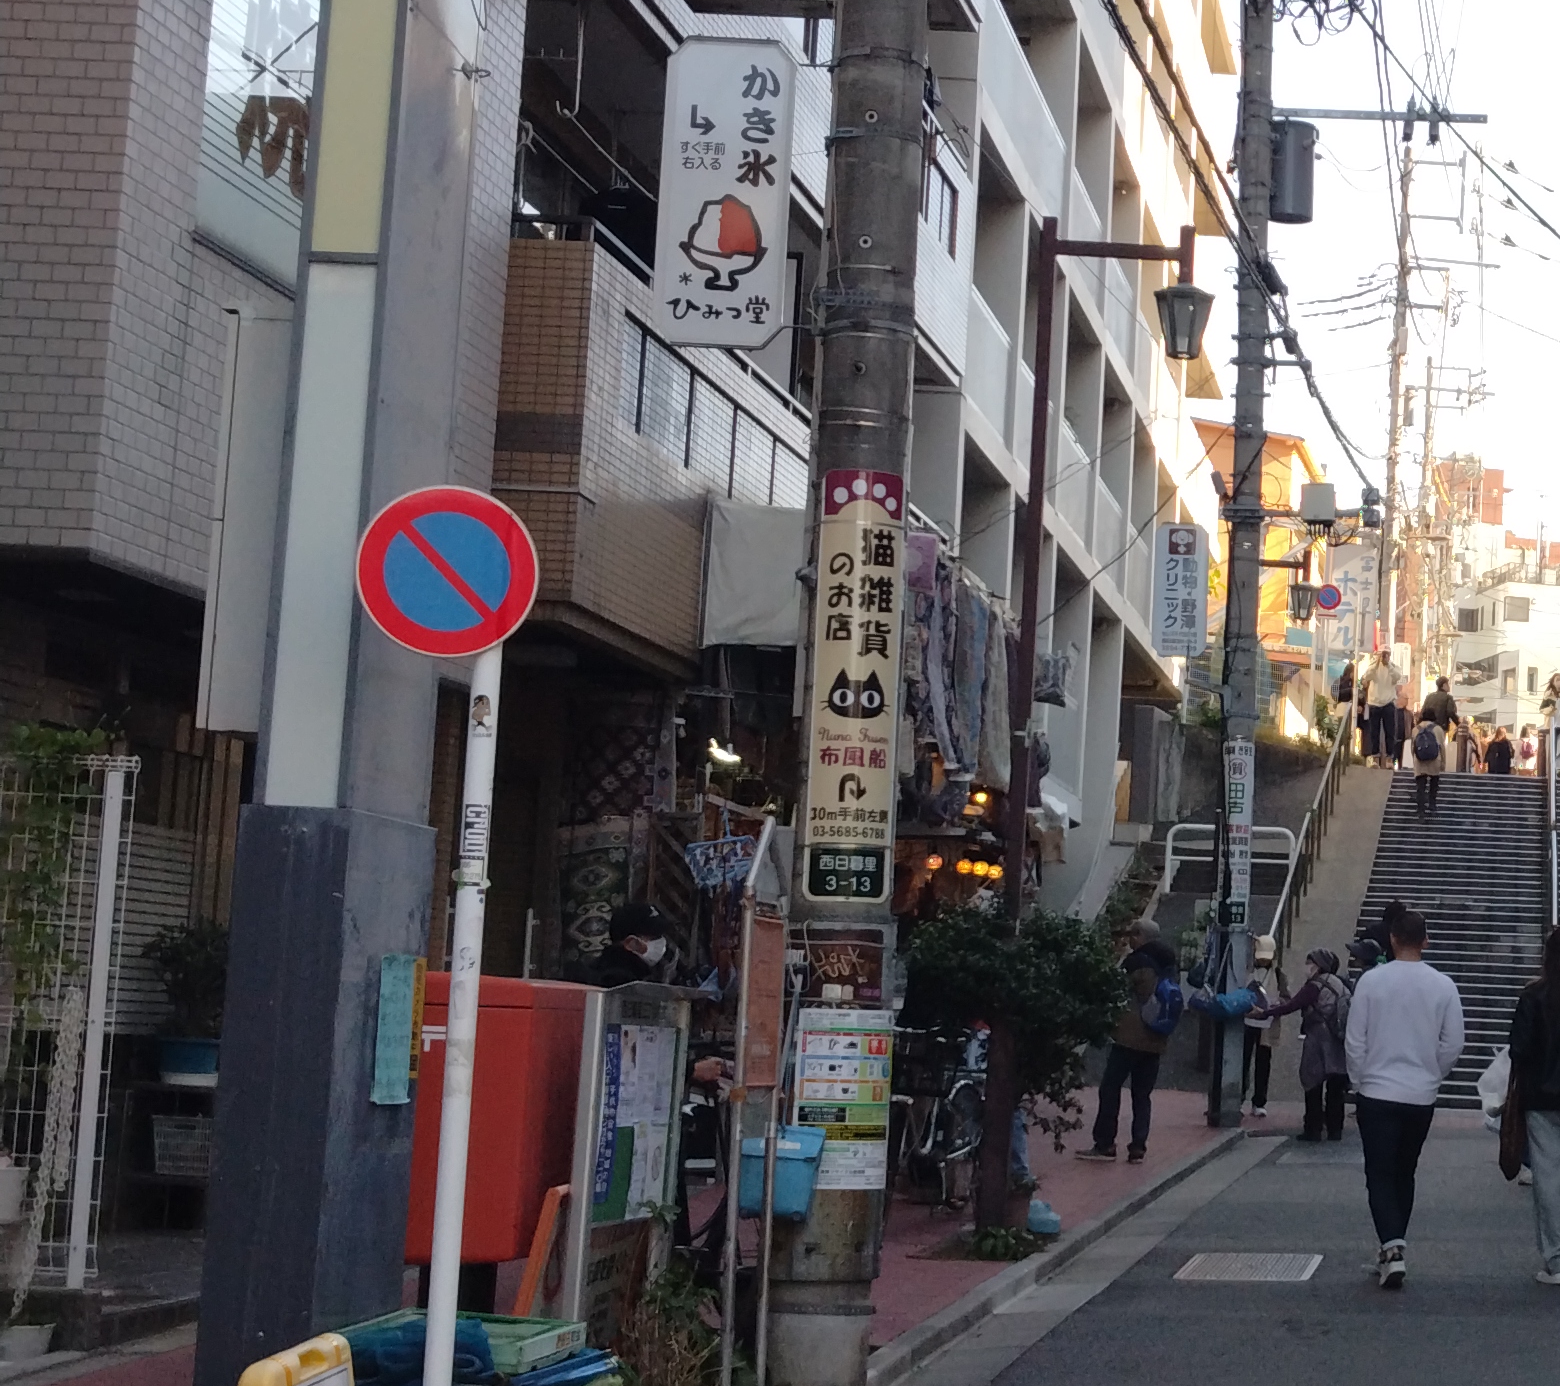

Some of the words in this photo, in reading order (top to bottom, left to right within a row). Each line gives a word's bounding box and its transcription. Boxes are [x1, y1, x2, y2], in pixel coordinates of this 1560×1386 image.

[735, 63, 781, 188] かき氷
[679, 140, 726, 156] すぐ手前
[682, 156, 722, 171] 右入る
[665, 295, 771, 326] ひみつ堂
[826, 552, 855, 641] のお店
[857, 528, 896, 660] 猫雑貨
[1164, 557, 1179, 629] クリニック
[1331, 570, 1358, 647] ホテル
[819, 745, 887, 769] 布風船
[819, 854, 878, 873] 西日暮里
[824, 875, 871, 894] 3-13
